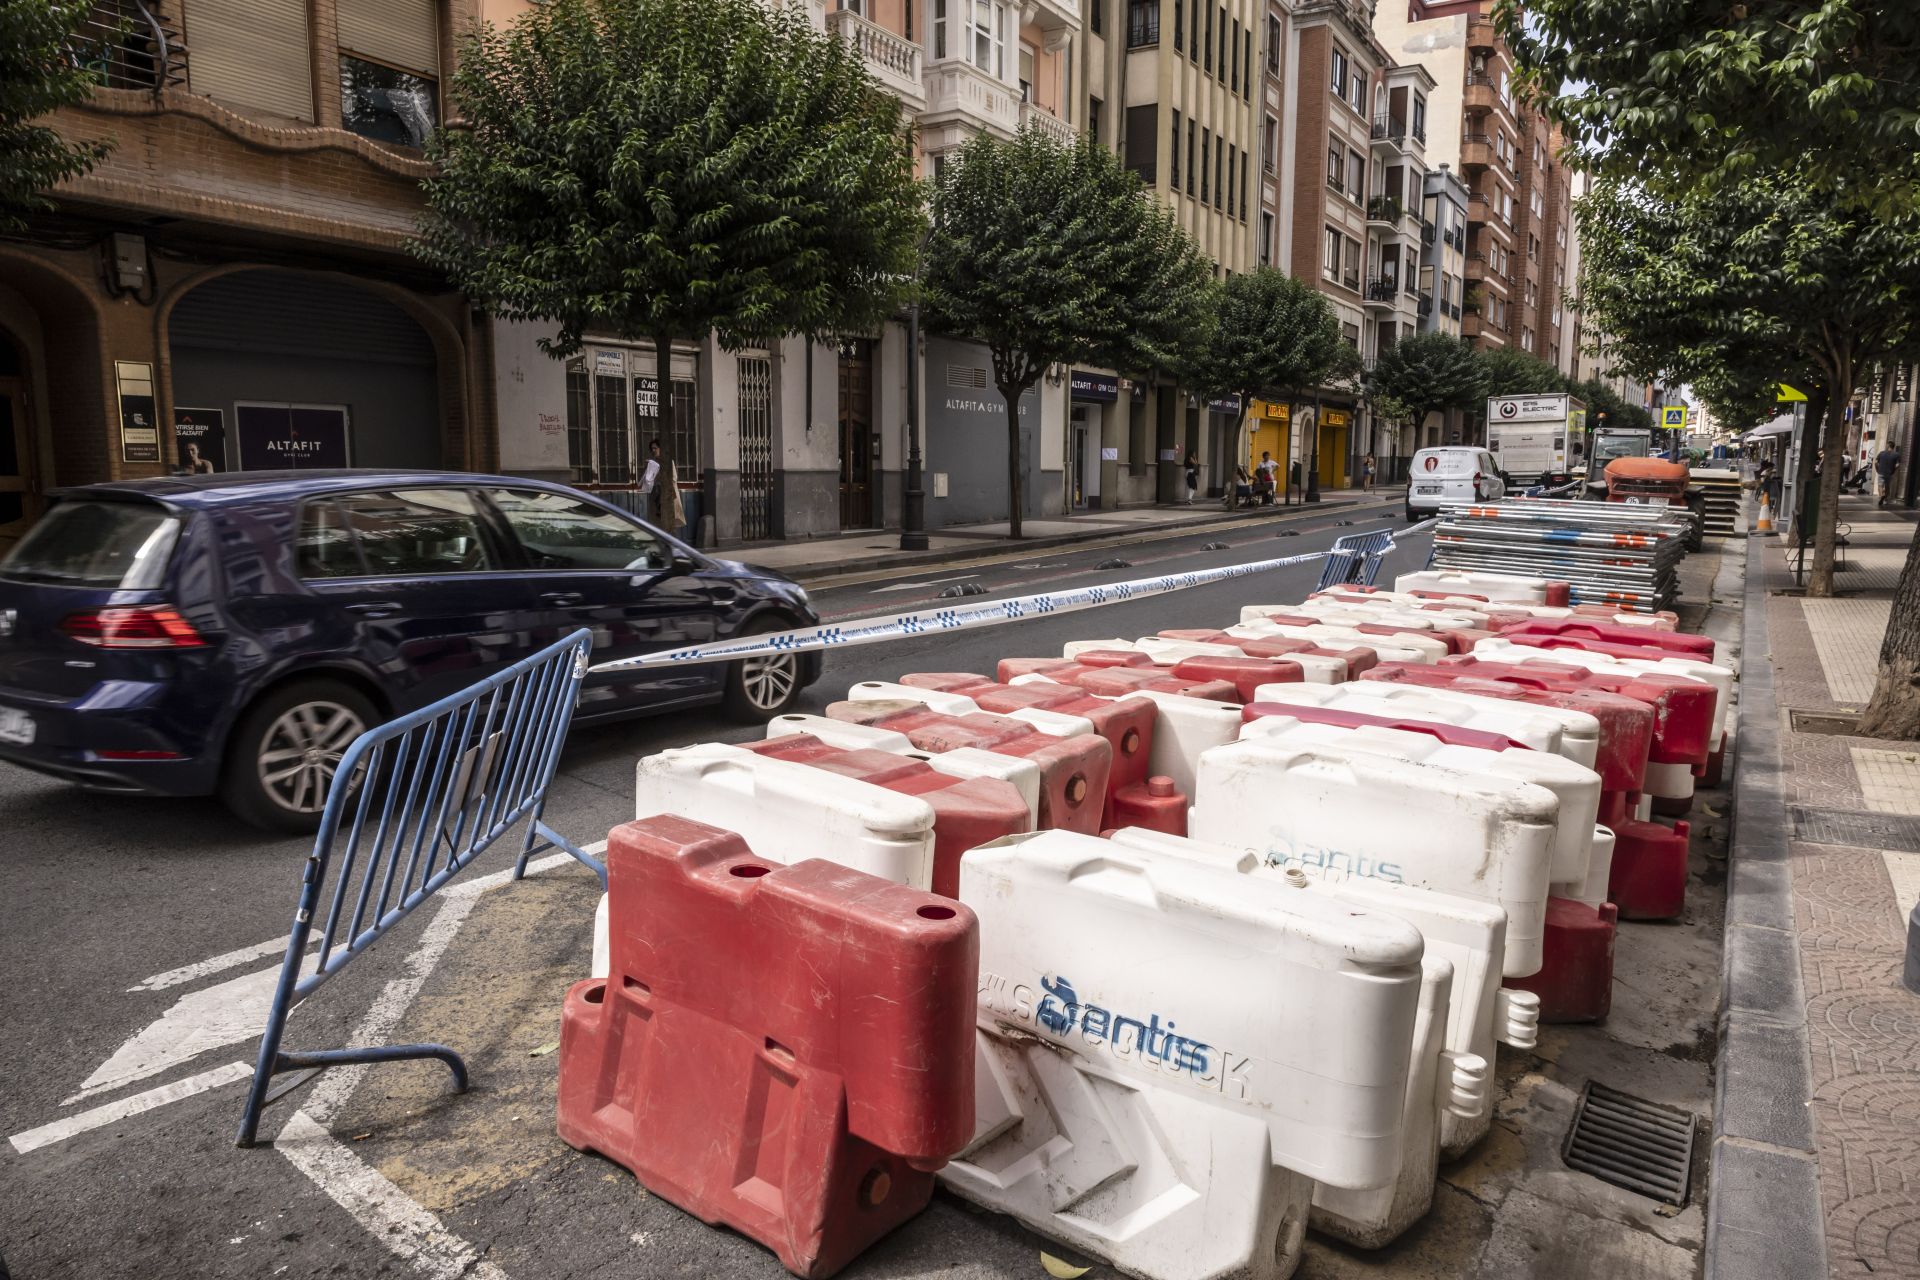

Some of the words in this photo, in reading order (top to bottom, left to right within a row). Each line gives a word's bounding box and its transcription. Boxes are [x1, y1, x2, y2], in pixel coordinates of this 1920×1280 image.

[1071, 380, 1091, 390] ALTAFIT
[1098, 383, 1107, 392] GYM
[649, 393, 658, 403] 48
[640, 405, 649, 417] SE
[650, 405, 658, 417] VE
[946, 399, 977, 412] ALTAFIT
[987, 402, 1004, 414] GYM
[267, 440, 321, 451] ALTAFIT
